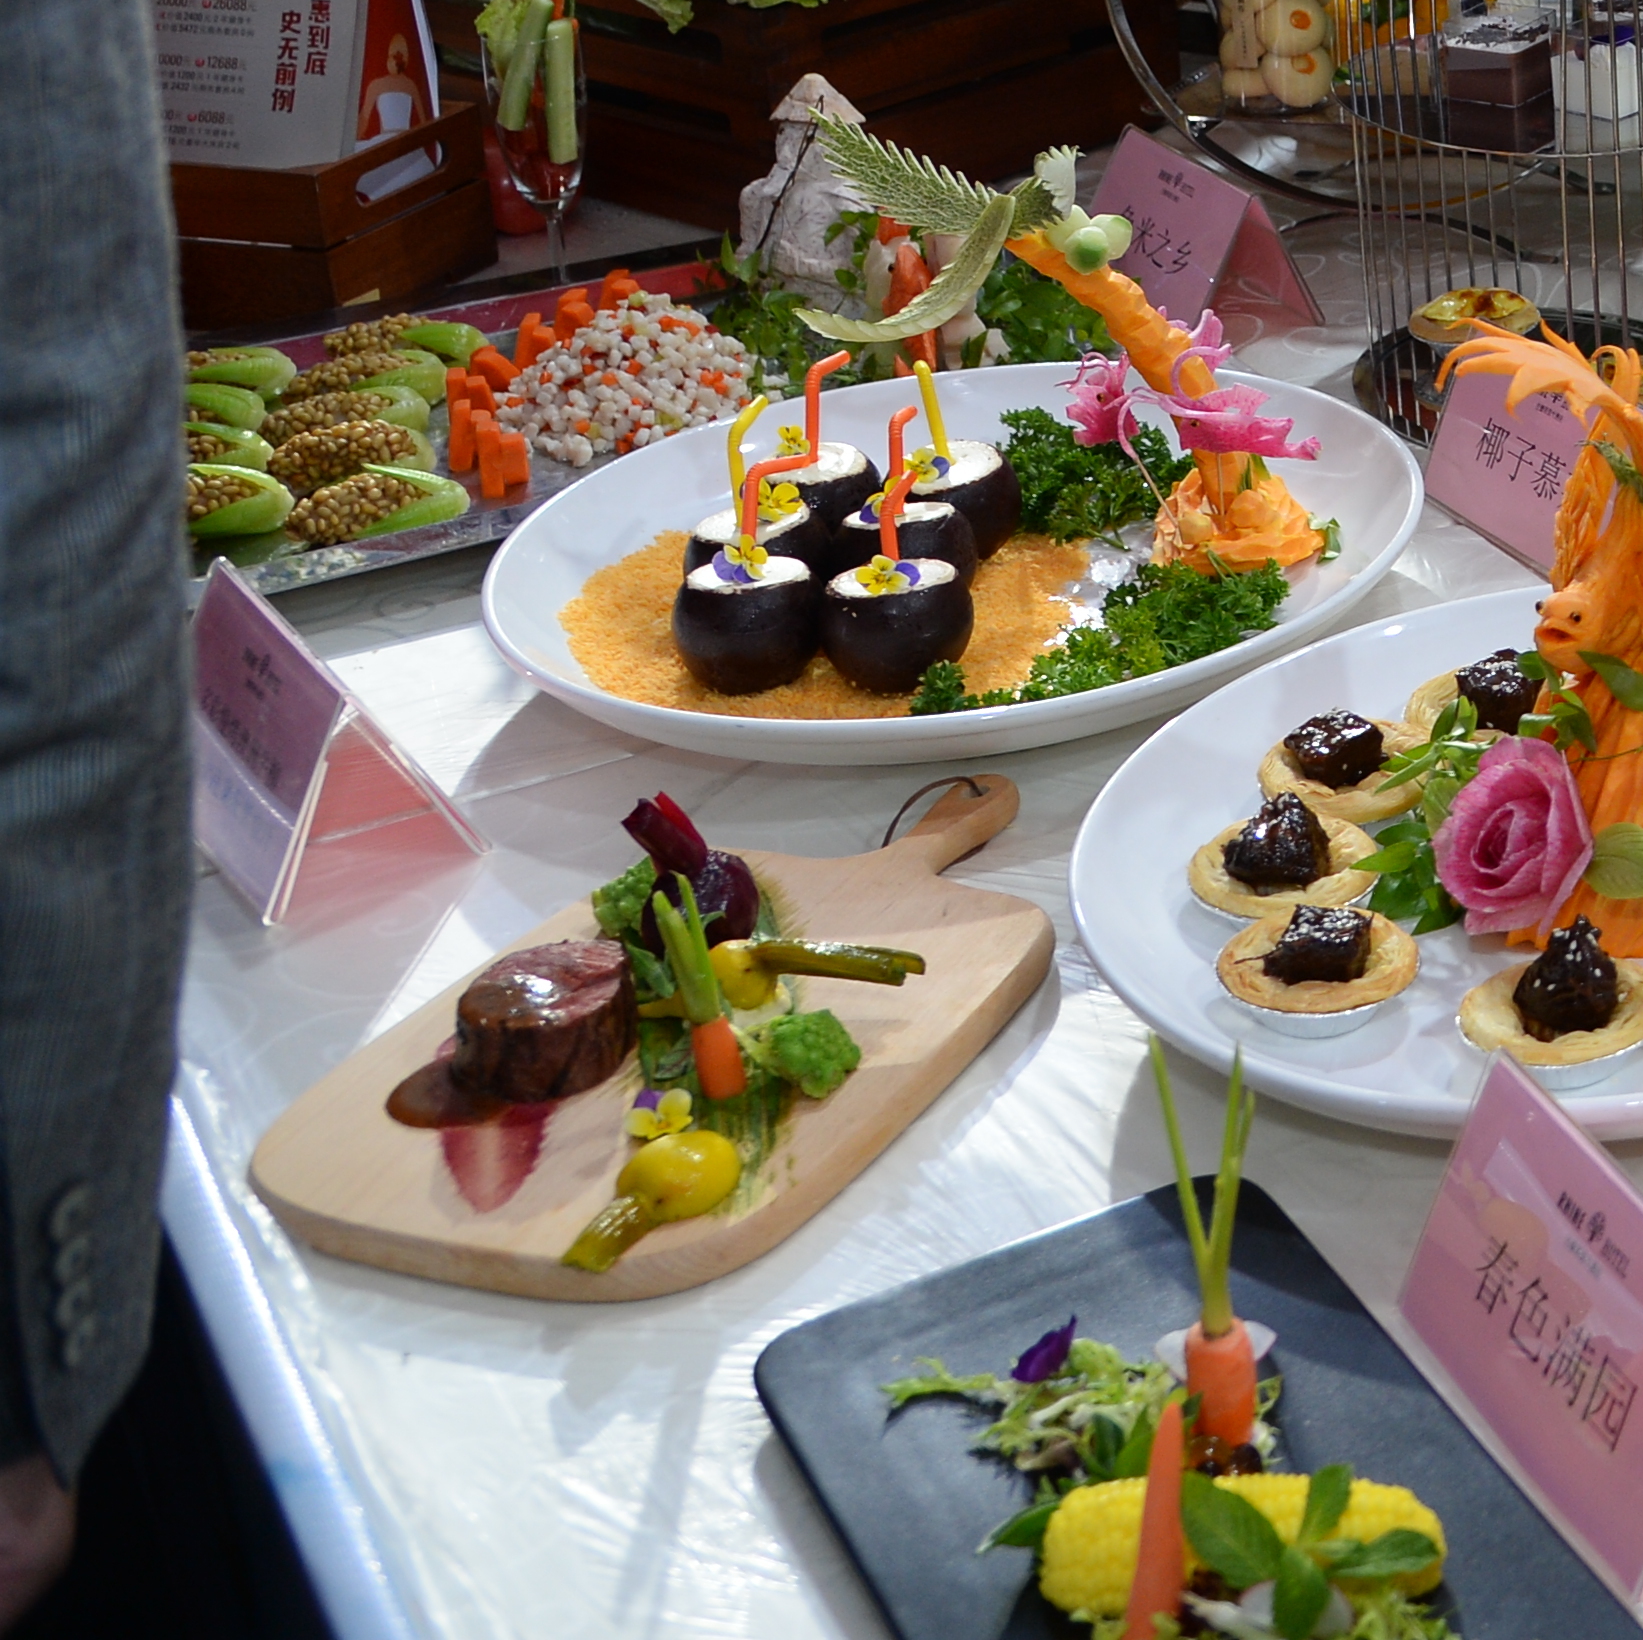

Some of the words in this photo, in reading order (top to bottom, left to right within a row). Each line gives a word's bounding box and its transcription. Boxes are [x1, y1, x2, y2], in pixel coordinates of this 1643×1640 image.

[272, 9, 301, 113] 史无前例
[1476, 417, 1572, 508] 椰子慕
[1557, 1192, 1587, 1229] RHINE
[1475, 1236, 1638, 1454] 春色满园
